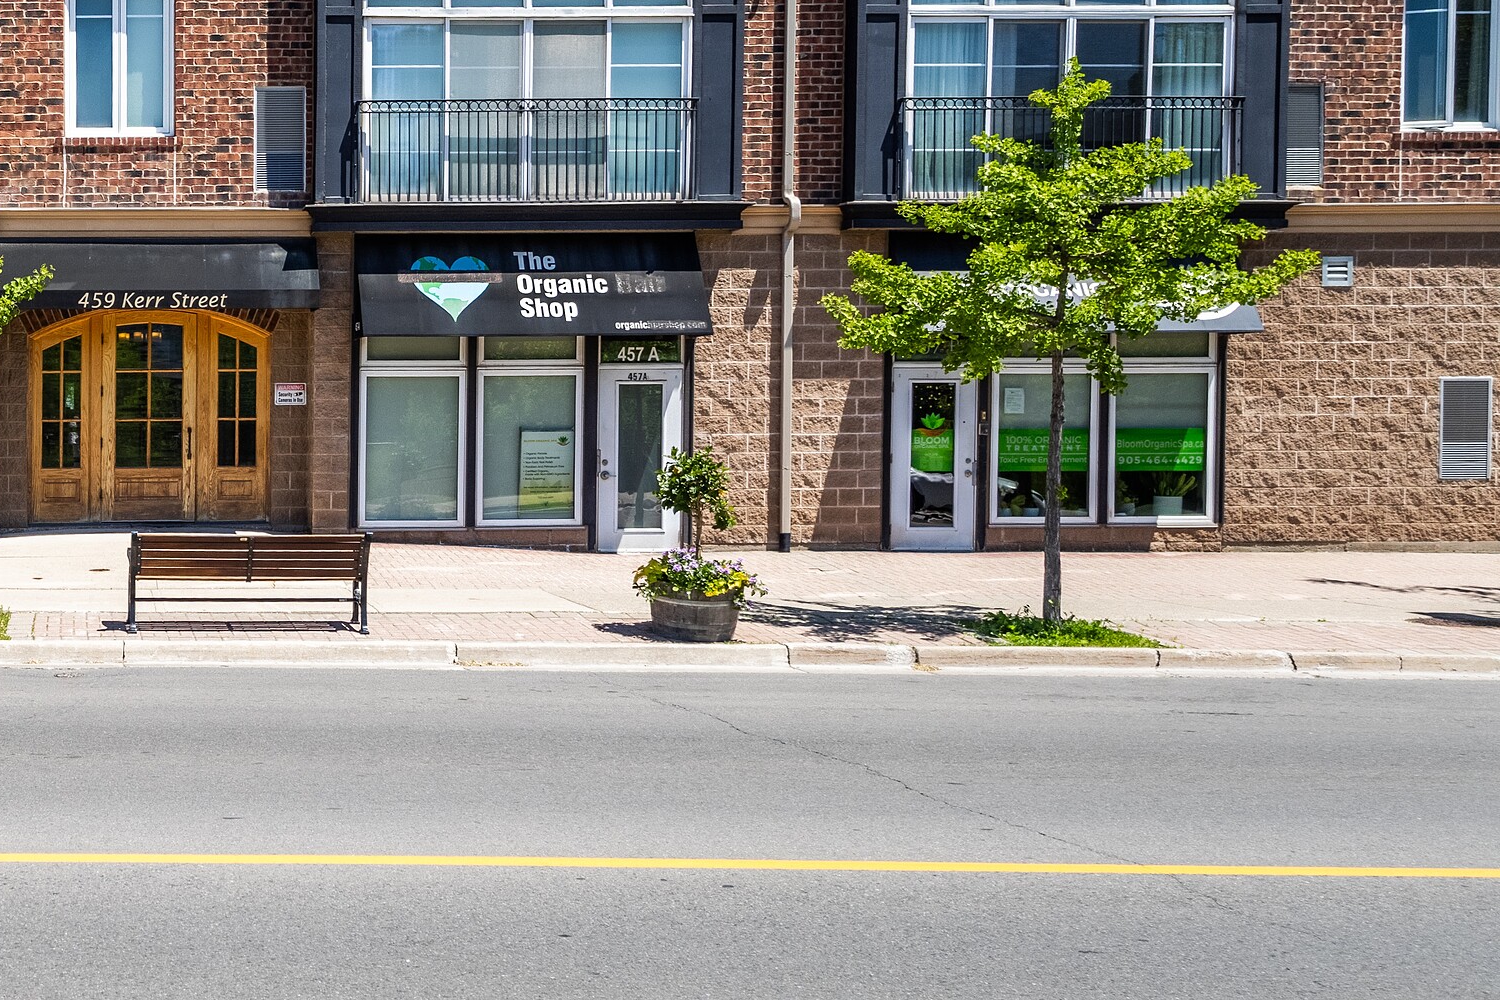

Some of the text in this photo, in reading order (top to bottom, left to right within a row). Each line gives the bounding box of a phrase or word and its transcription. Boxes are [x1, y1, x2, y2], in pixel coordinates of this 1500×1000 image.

[513, 251, 556, 270] The
[516, 274, 609, 298] Organic
[77, 291, 228, 309] 459 Kerr Street
[519, 297, 579, 322] Shop
[617, 346, 660, 361] 457 A
[627, 373, 648, 381] 457A
[1006, 436, 1032, 444] 100%
